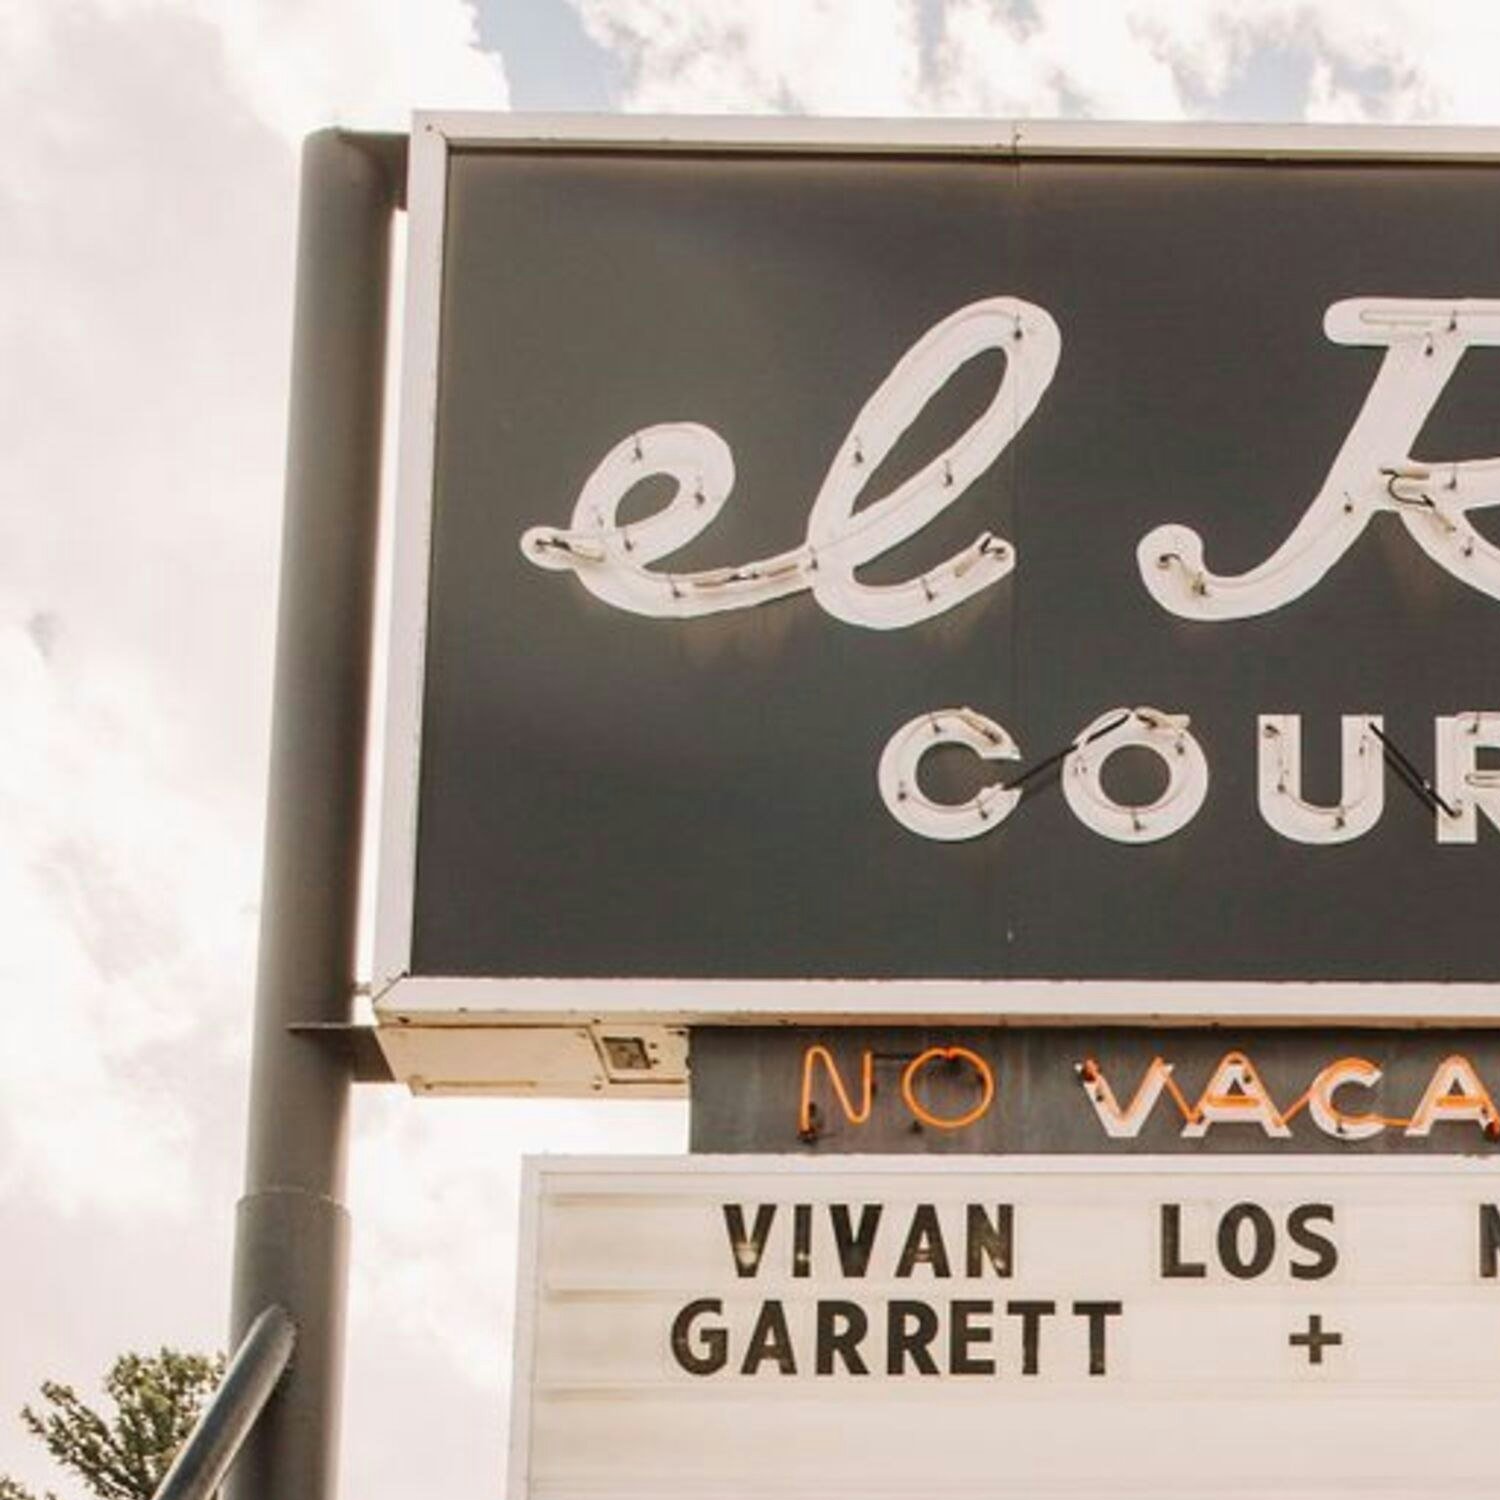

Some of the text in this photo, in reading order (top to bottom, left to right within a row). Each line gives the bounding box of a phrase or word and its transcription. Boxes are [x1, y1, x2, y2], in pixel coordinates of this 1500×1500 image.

[519, 294, 1062, 628] el
[799, 1046, 995, 1137] NO
[722, 1202, 1017, 1280] VIVAN
[1160, 1201, 1341, 1280] LOS
[670, 1298, 1124, 1377] GARRETT
